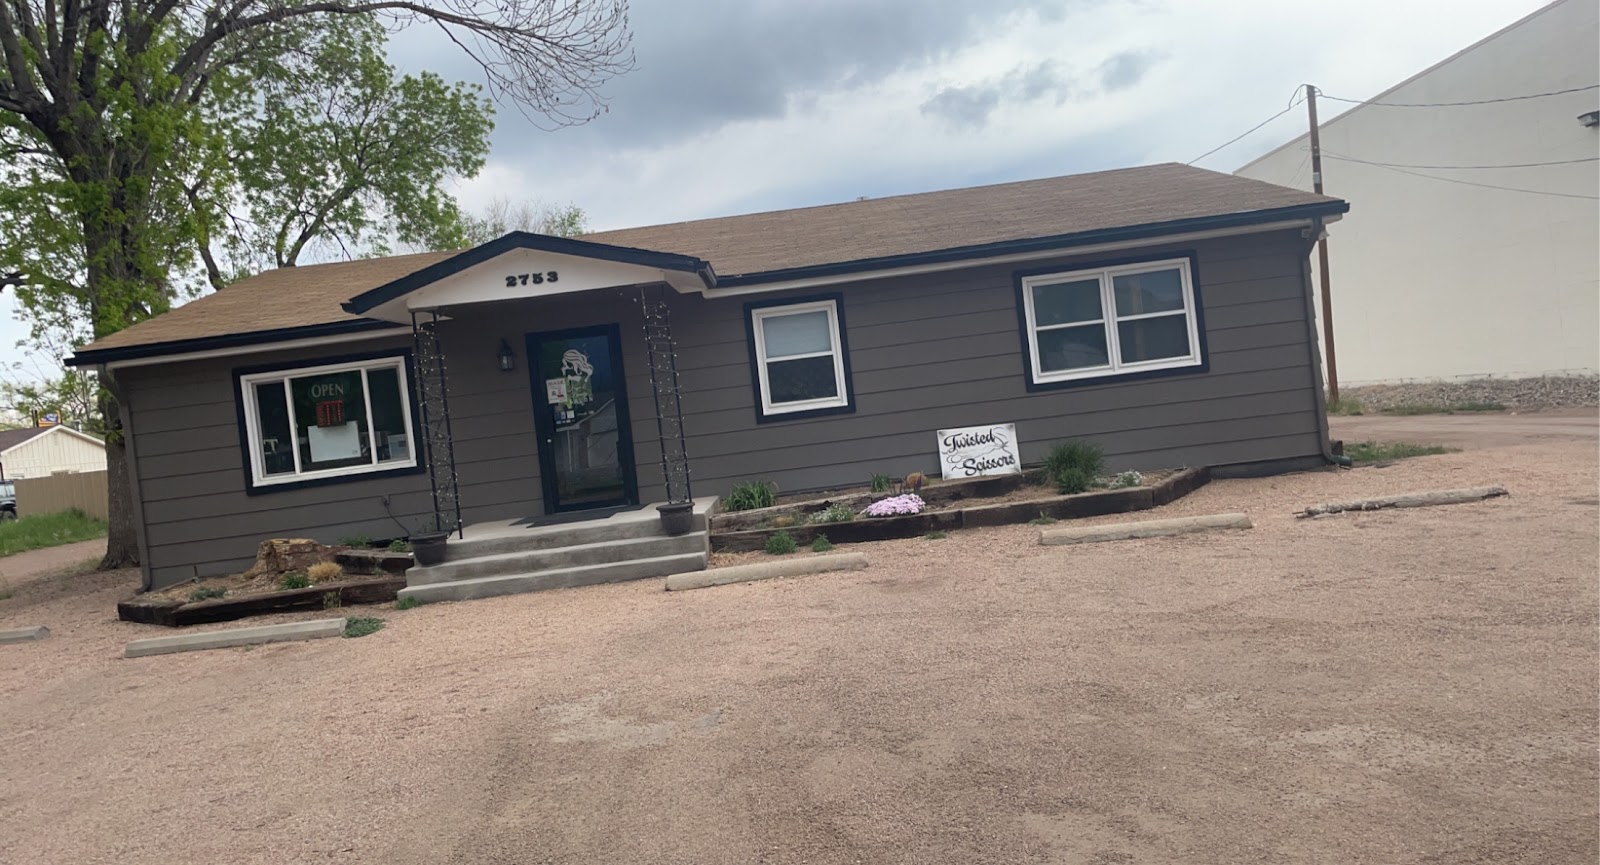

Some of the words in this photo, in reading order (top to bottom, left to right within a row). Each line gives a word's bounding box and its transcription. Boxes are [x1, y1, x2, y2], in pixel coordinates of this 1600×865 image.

[505, 271, 559, 287] 2753
[311, 383, 344, 398] OPEN
[943, 428, 996, 453] Twisted
[954, 455, 1016, 476] Scissors
